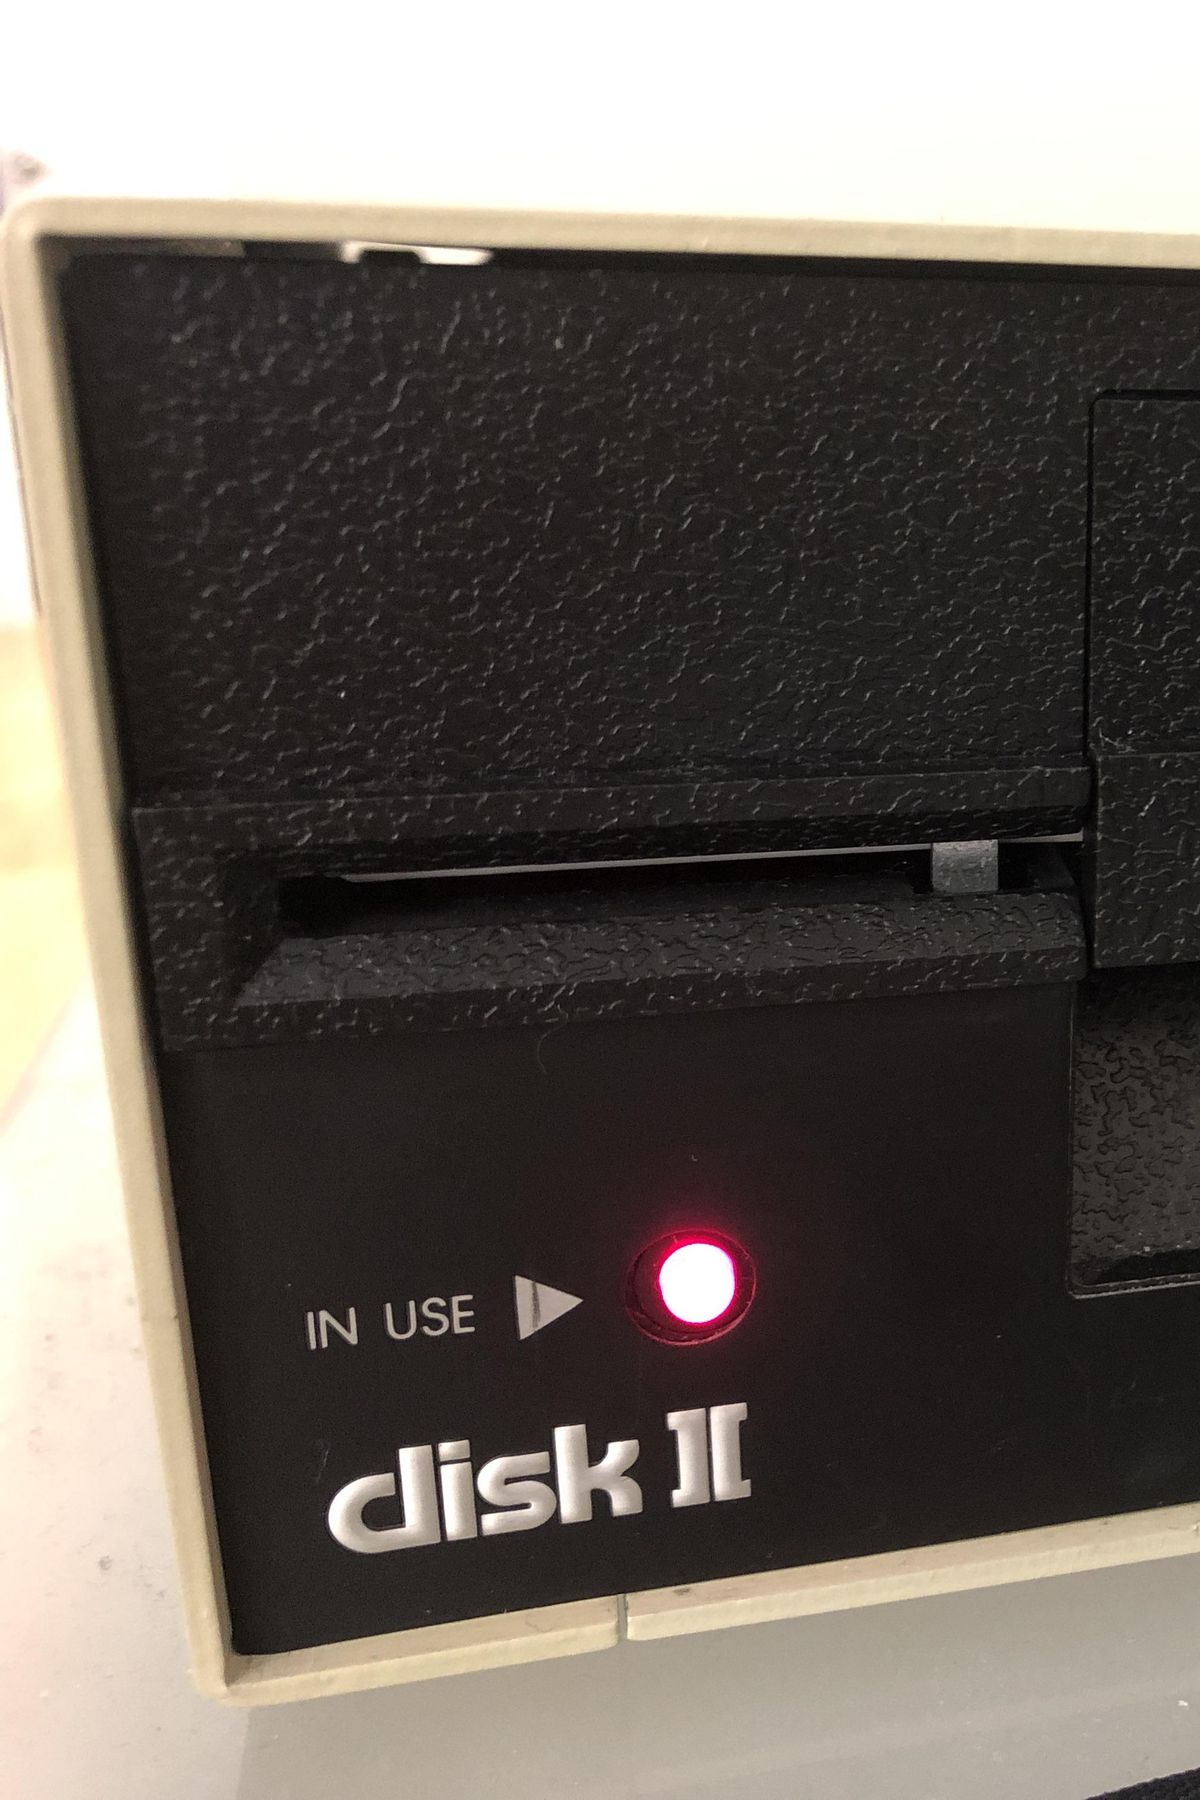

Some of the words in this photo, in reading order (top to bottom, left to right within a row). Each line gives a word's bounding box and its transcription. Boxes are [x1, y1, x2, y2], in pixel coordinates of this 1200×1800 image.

[306, 1306, 359, 1351] IN
[383, 1294, 476, 1340] USE
[327, 1423, 643, 1554] disk
